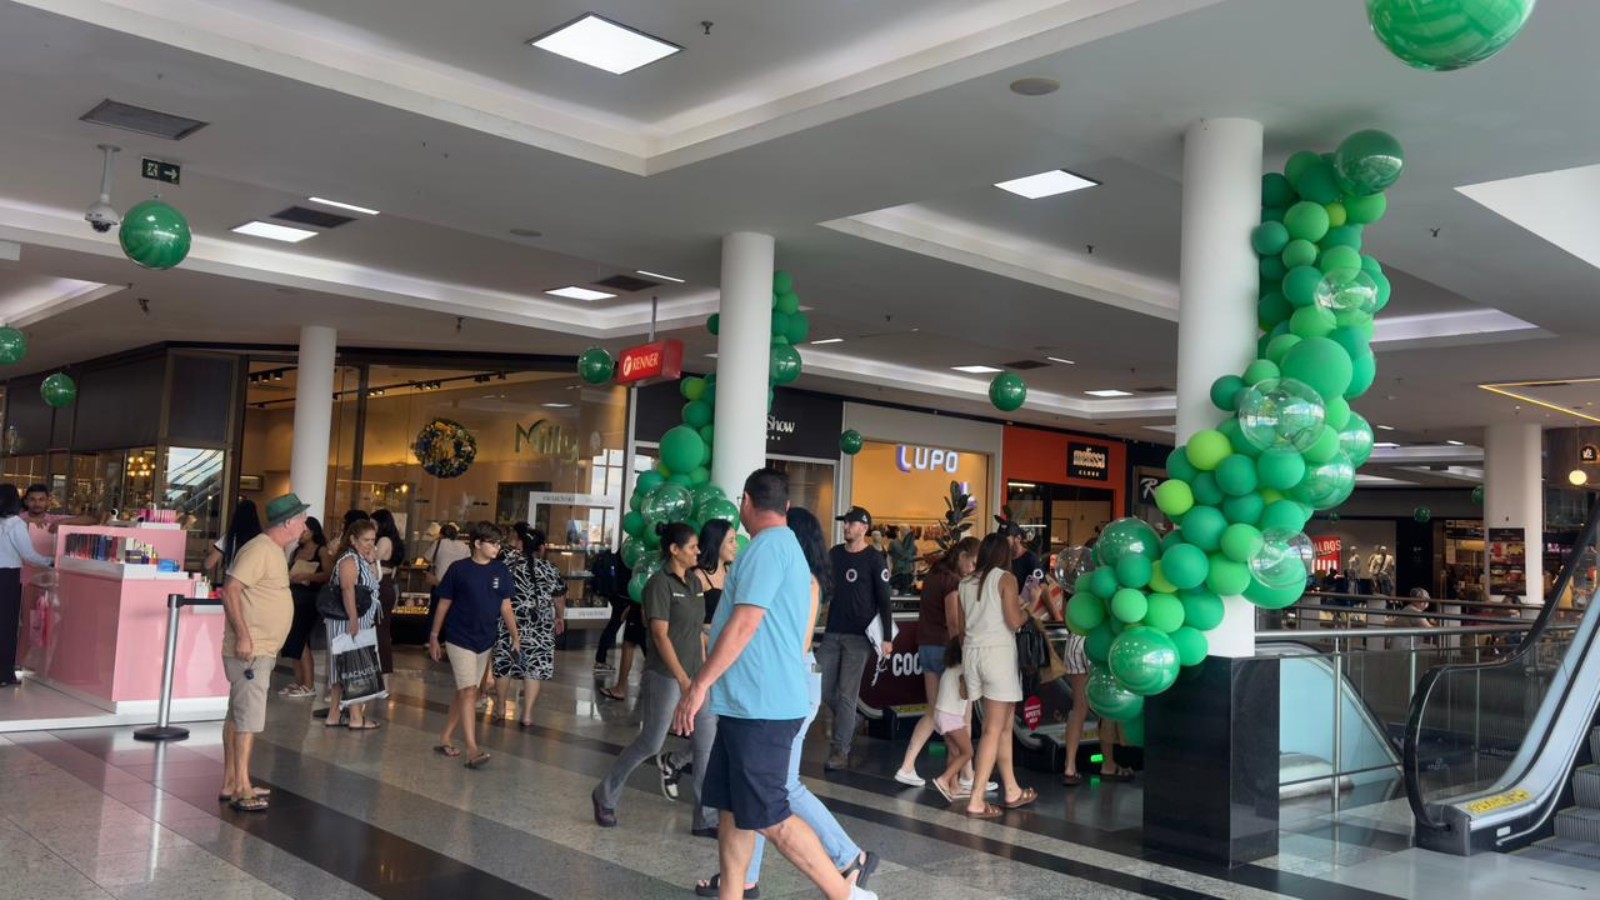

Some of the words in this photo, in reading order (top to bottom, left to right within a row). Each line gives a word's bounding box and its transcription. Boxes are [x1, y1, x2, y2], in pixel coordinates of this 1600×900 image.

[632, 352, 659, 371] RENNER
[897, 445, 958, 474] LUPO
[1314, 540, 1342, 552] ALDOS
